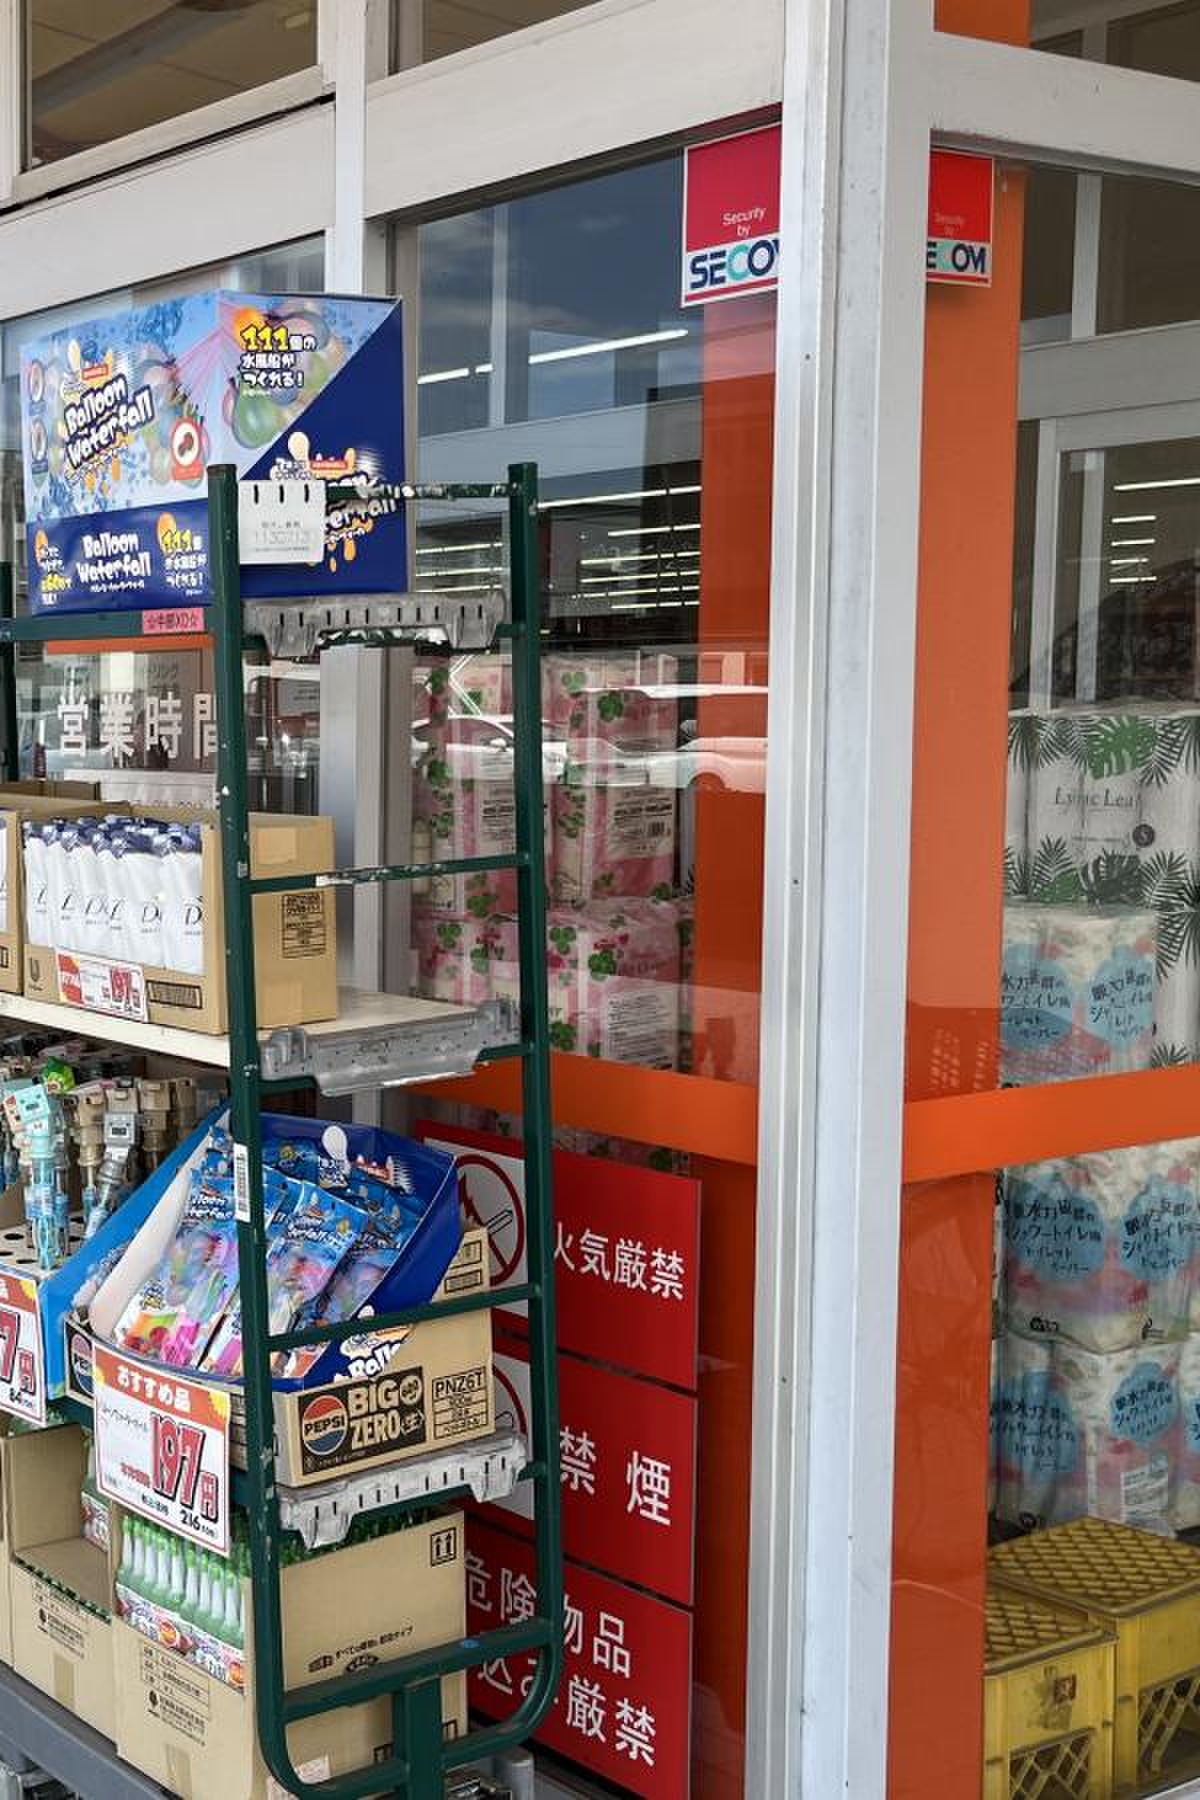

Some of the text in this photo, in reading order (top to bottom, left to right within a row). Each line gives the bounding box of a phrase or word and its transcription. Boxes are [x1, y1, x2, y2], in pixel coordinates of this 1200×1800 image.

[722, 207, 767, 227] Security
[736, 224, 751, 238] by
[690, 238, 780, 290] SECO
[926, 241, 986, 274] ECOM
[65, 374, 128, 434] Balloon
[66, 386, 154, 469] Waterfall
[82, 532, 139, 559] Balloon
[76, 552, 151, 583] Waterfall
[554, 1221, 687, 1300] 火気厳禁
[117, 1364, 192, 1413] おすすめ品
[348, 1378, 400, 1417] BIG
[436, 1371, 482, 1398] PNZ6T
[305, 1414, 346, 1437] PEPSI
[350, 1409, 400, 1451] ZERO
